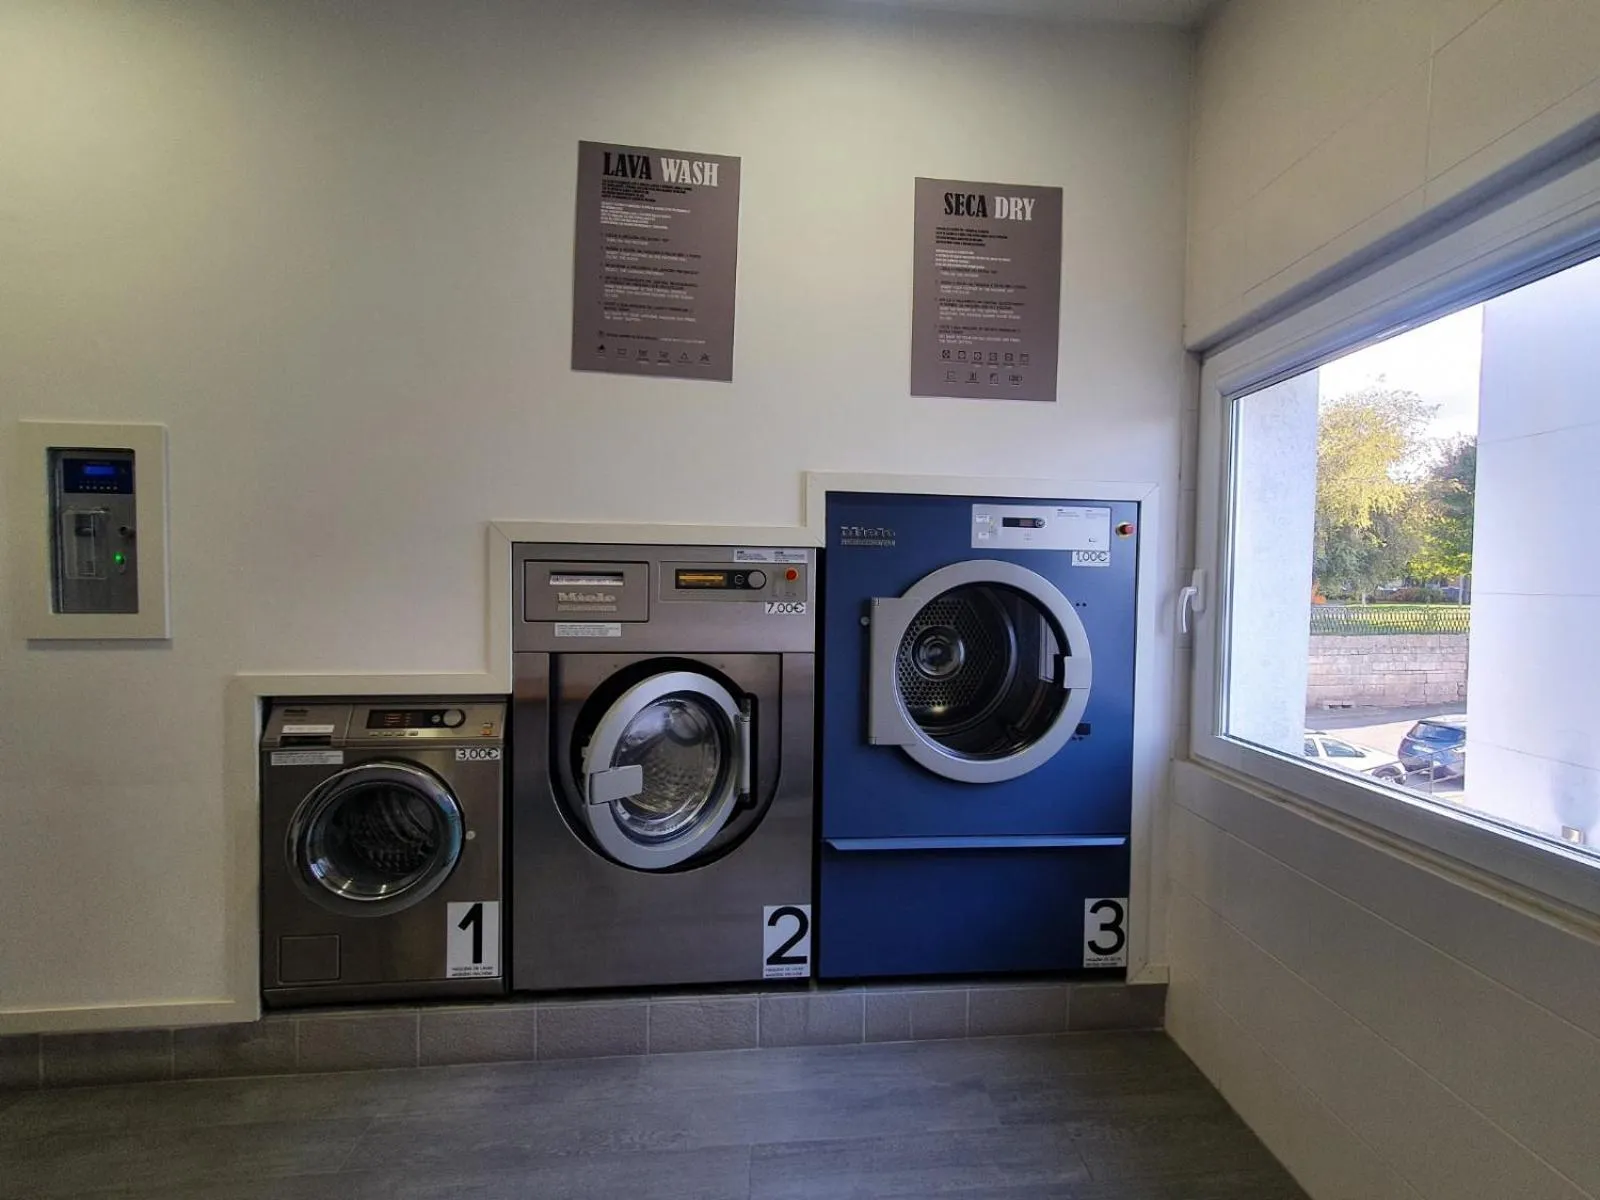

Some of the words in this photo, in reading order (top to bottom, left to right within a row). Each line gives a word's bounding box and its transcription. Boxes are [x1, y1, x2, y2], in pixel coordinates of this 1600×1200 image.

[602, 151, 652, 180] LAVA
[660, 157, 720, 187] WASH
[944, 192, 988, 218] SECA
[994, 196, 1035, 221] DRY
[457, 902, 483, 964] 1
[766, 905, 809, 966] 2
[1087, 899, 1125, 956] 3
